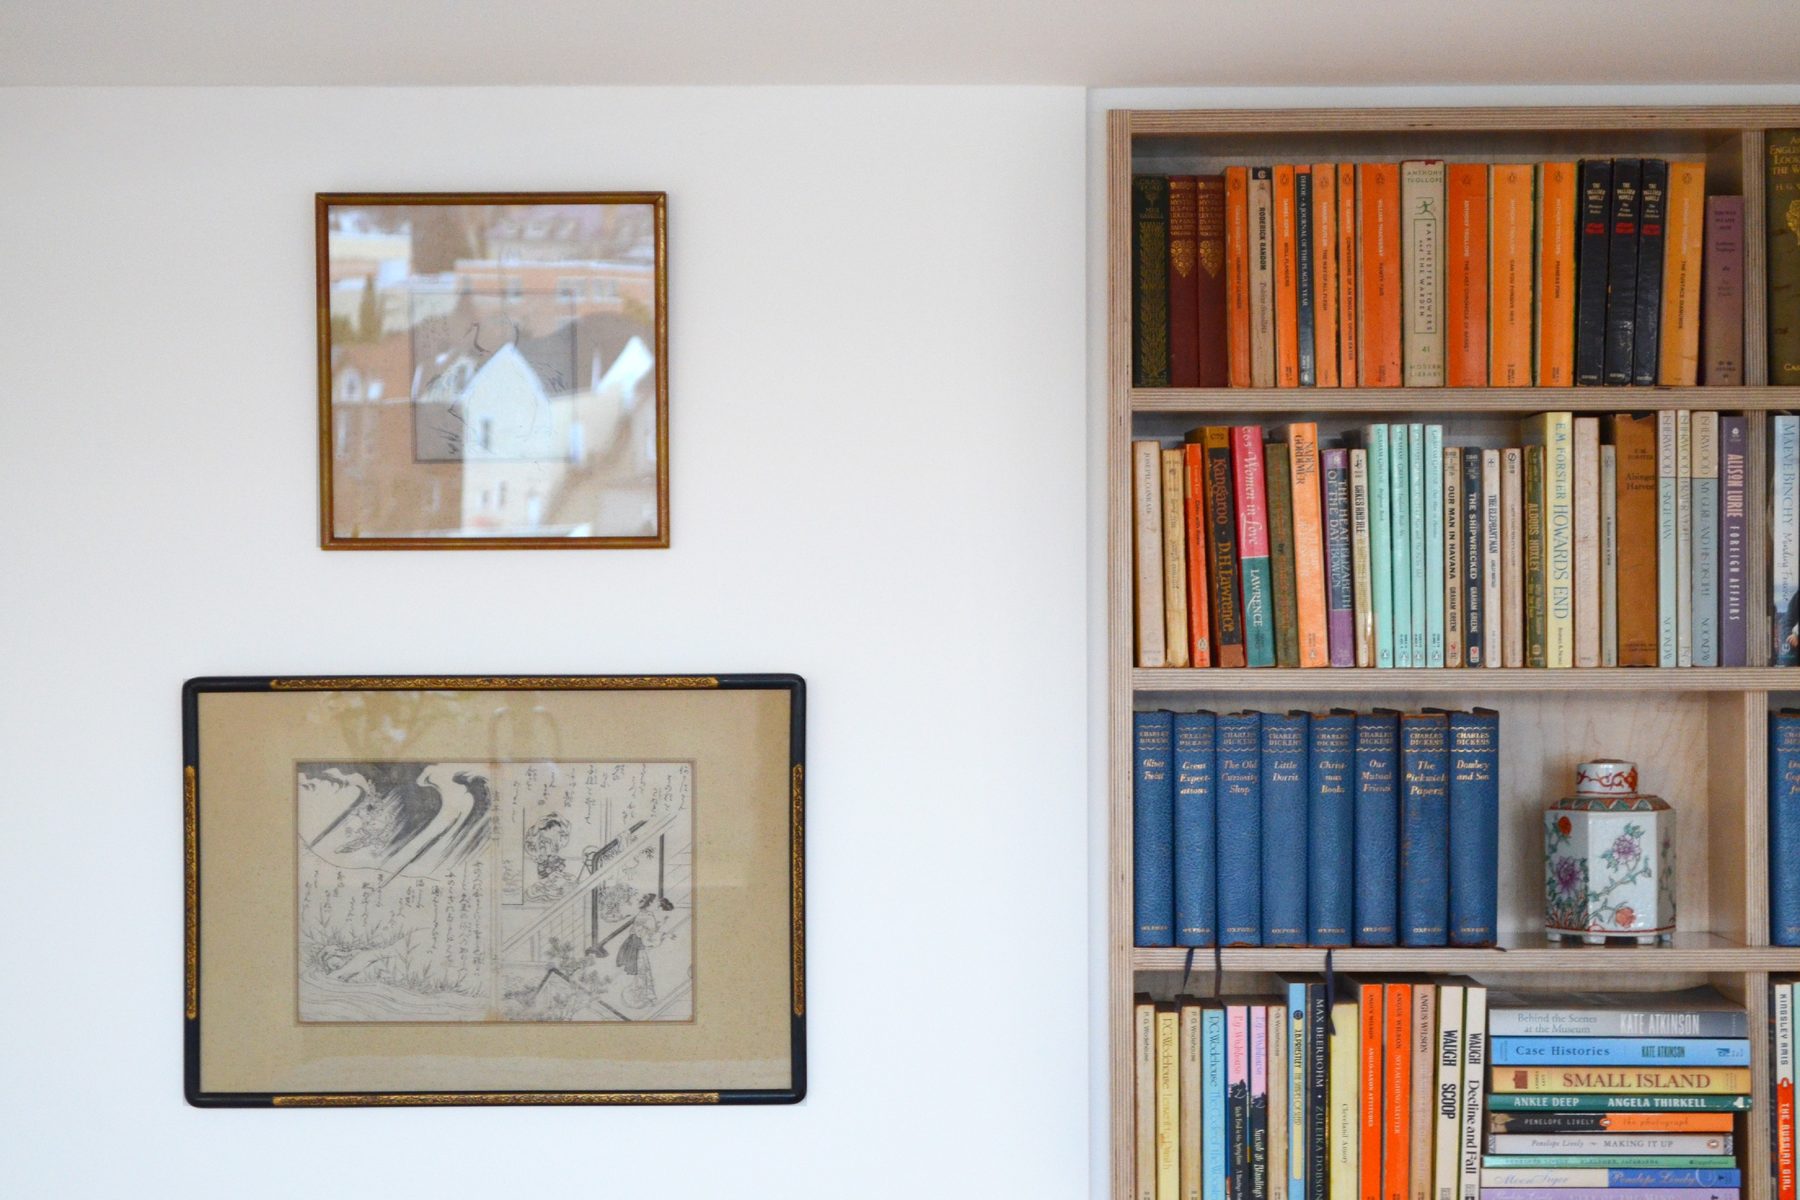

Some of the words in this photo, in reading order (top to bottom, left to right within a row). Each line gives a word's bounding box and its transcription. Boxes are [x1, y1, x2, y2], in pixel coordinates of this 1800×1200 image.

[1301, 238, 1307, 248] OF
[1663, 416, 1671, 475] ISHERWOOD
[1680, 415, 1688, 476] ISHERWOOD
[1699, 416, 1710, 475] ISHERWOOD
[1782, 423, 1795, 467] MAEVE
[1144, 453, 1152, 480] JOSEPH
[1295, 435, 1305, 484] GORDIMER
[1304, 442, 1314, 473] NADINE
[1244, 451, 1260, 499] Women
[1328, 471, 1337, 485] OF
[1555, 447, 1566, 500] FORSTER
[1727, 454, 1743, 487] ALISON
[1212, 459, 1228, 524] Kangaroo
[1329, 490, 1338, 515] THE
[1338, 480, 1347, 506] THE
[1355, 485, 1365, 506] CAKES
[1447, 486, 1455, 505] OUR
[1468, 492, 1477, 510] THE
[1488, 495, 1497, 507] THE
[1782, 472, 1795, 527] BINCHY
[1246, 505, 1256, 516] in
[1355, 508, 1365, 521] AND
[1726, 490, 1743, 518] LURIE
[1339, 509, 1348, 542] HEAT
[1356, 522, 1365, 533] ALE
[1448, 508, 1456, 528] MAN
[1488, 508, 1498, 539] ELEPHANT
[1527, 503, 1539, 536] ALDOUS
[1663, 519, 1672, 540] MAN
[1330, 520, 1339, 542] DAY
[1448, 531, 1456, 540] IN
[1553, 504, 1569, 580] HOWARDS
[1699, 525, 1710, 545] AND
[1469, 514, 1478, 580] SHIPWRECKED
[1489, 540, 1498, 554] MAN
[1528, 539, 1540, 572] HUXLEY
[1699, 548, 1710, 560] HIS
[1729, 526, 1740, 572] FOREIGN
[1332, 548, 1341, 588] BOWEN
[1448, 544, 1457, 579] HAVANA
[1341, 548, 1351, 608] ELIZABETH
[1247, 569, 1262, 626] LAWRENCE
[1449, 587, 1457, 610] GRAHAM
[1470, 587, 1478, 610] GRAHAM
[1553, 586, 1569, 620] END
[1729, 578, 1740, 620] AFFAIRS
[1449, 612, 1457, 632] GREENE
[1470, 612, 1479, 633] GREENE
[1700, 618, 1710, 662] NOONDAY
[1274, 760, 1297, 769] Little
[1369, 760, 1387, 768] Our
[1417, 761, 1436, 770] The
[1456, 760, 1489, 770] Dombey
[1272, 773, 1299, 782] Dorrit
[1361, 772, 1392, 781] Mutual
[1456, 773, 1473, 781] and
[1475, 772, 1489, 781] Son
[1229, 786, 1250, 795] Shop
[1410, 786, 1444, 796] Papers
[1316, 999, 1324, 1023] MAX
[1420, 993, 1428, 1020] ANGUS
[1780, 994, 1788, 1039] KINGSLEY
[1518, 1013, 1549, 1024] Behind
[1551, 1013, 1566, 1023] the
[1569, 1013, 1597, 1023] Scenes
[1524, 1025, 1534, 1033] at
[1536, 1024, 1550, 1033] the
[1552, 1024, 1590, 1033] Museum
[1620, 1014, 1644, 1034] KATE
[1648, 1014, 1700, 1035] ATKINSON
[1420, 1022, 1428, 1053] WILSON
[1442, 1030, 1458, 1066] WAUGH
[1468, 1033, 1482, 1064] WAUGH
[1316, 1027, 1324, 1087] BEERBOHM
[1395, 1055, 1401, 1065] NO
[1516, 1046, 1545, 1055] Case
[1552, 1046, 1610, 1056] Histories
[1641, 1046, 1656, 1057] KATE
[1658, 1046, 1685, 1057] ATKINSON
[1780, 1043, 1788, 1065] AMIS
[1563, 1074, 1631, 1088] SMALL
[1636, 1074, 1711, 1088] ISLAND
[1441, 1084, 1456, 1119] SCOOP
[1467, 1080, 1480, 1124] Decline
[1514, 1097, 1548, 1106] ANKLE
[1552, 1098, 1579, 1106] DEEP
[1608, 1098, 1648, 1107] ANGELA
[1654, 1098, 1706, 1107] THIRKELL
[1782, 1103, 1790, 1119] THE
[1315, 1106, 1323, 1152] ZULEIKA
[1623, 1118, 1636, 1126] the
[1640, 1118, 1688, 1128] photograph
[1466, 1126, 1479, 1148] and
[1531, 1139, 1561, 1148] Penelope
[1562, 1139, 1584, 1148] Lively
[1466, 1151, 1477, 1174] Fall
[1254, 1164, 1264, 1199] Blandings
[1315, 1155, 1323, 1200] DOBSON
[1782, 1169, 1790, 1191] GIRL
